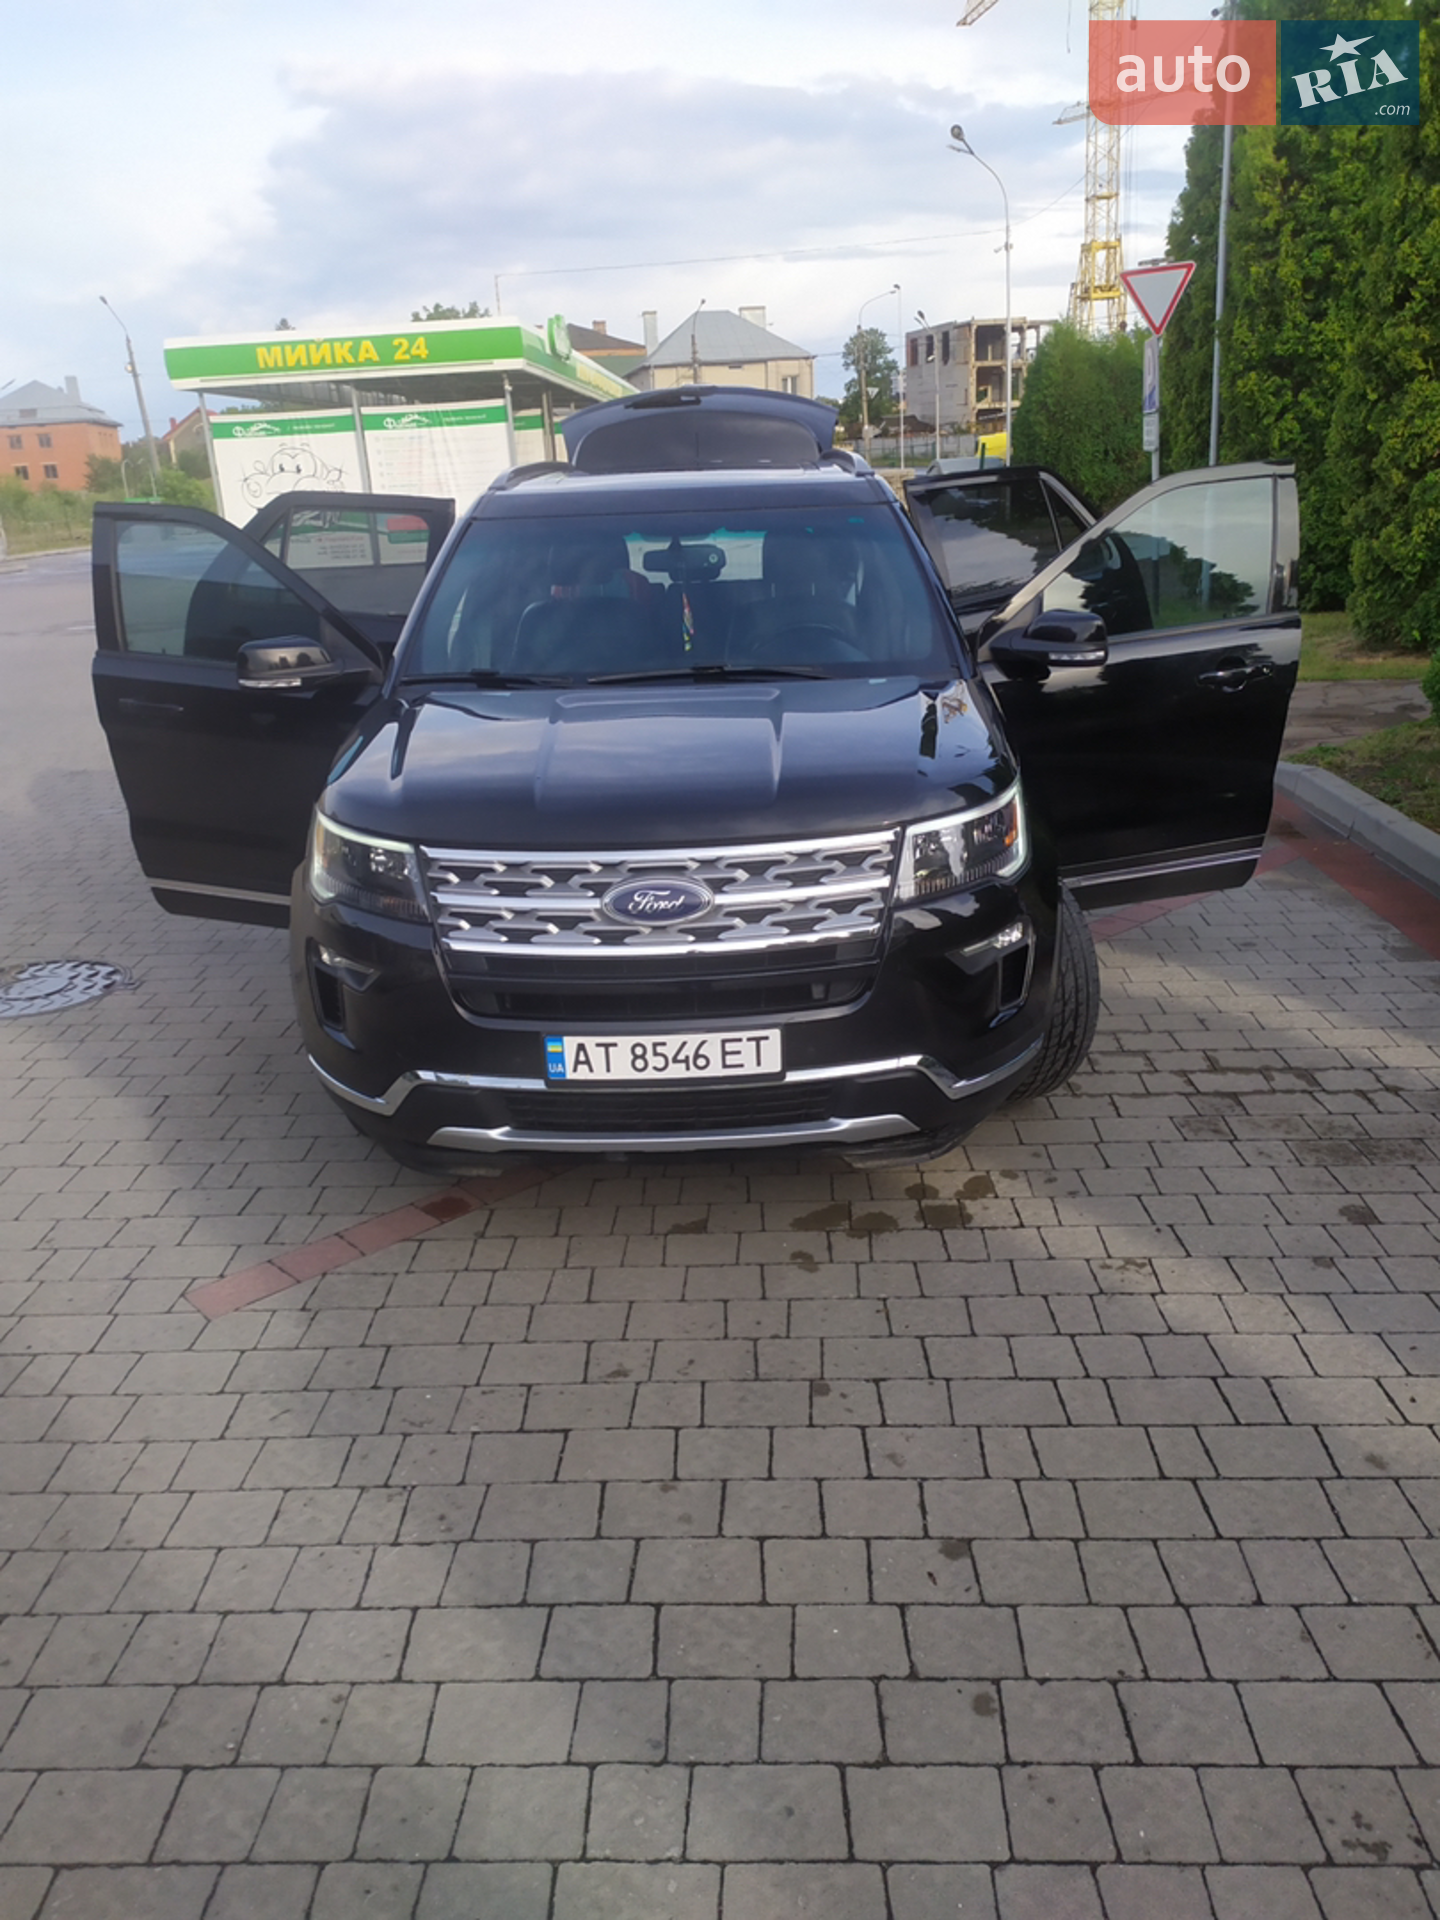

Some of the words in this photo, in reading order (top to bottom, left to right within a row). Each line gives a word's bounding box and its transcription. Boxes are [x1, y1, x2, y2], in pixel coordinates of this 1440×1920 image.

[256, 337, 380, 369] МИЙКА
[392, 337, 429, 362] 24
[628, 889, 686, 913] Ford
[548, 1063, 565, 1074] UA
[572, 1042, 618, 1073] AT
[630, 1040, 710, 1073] 8546
[721, 1036, 770, 1069] ET
